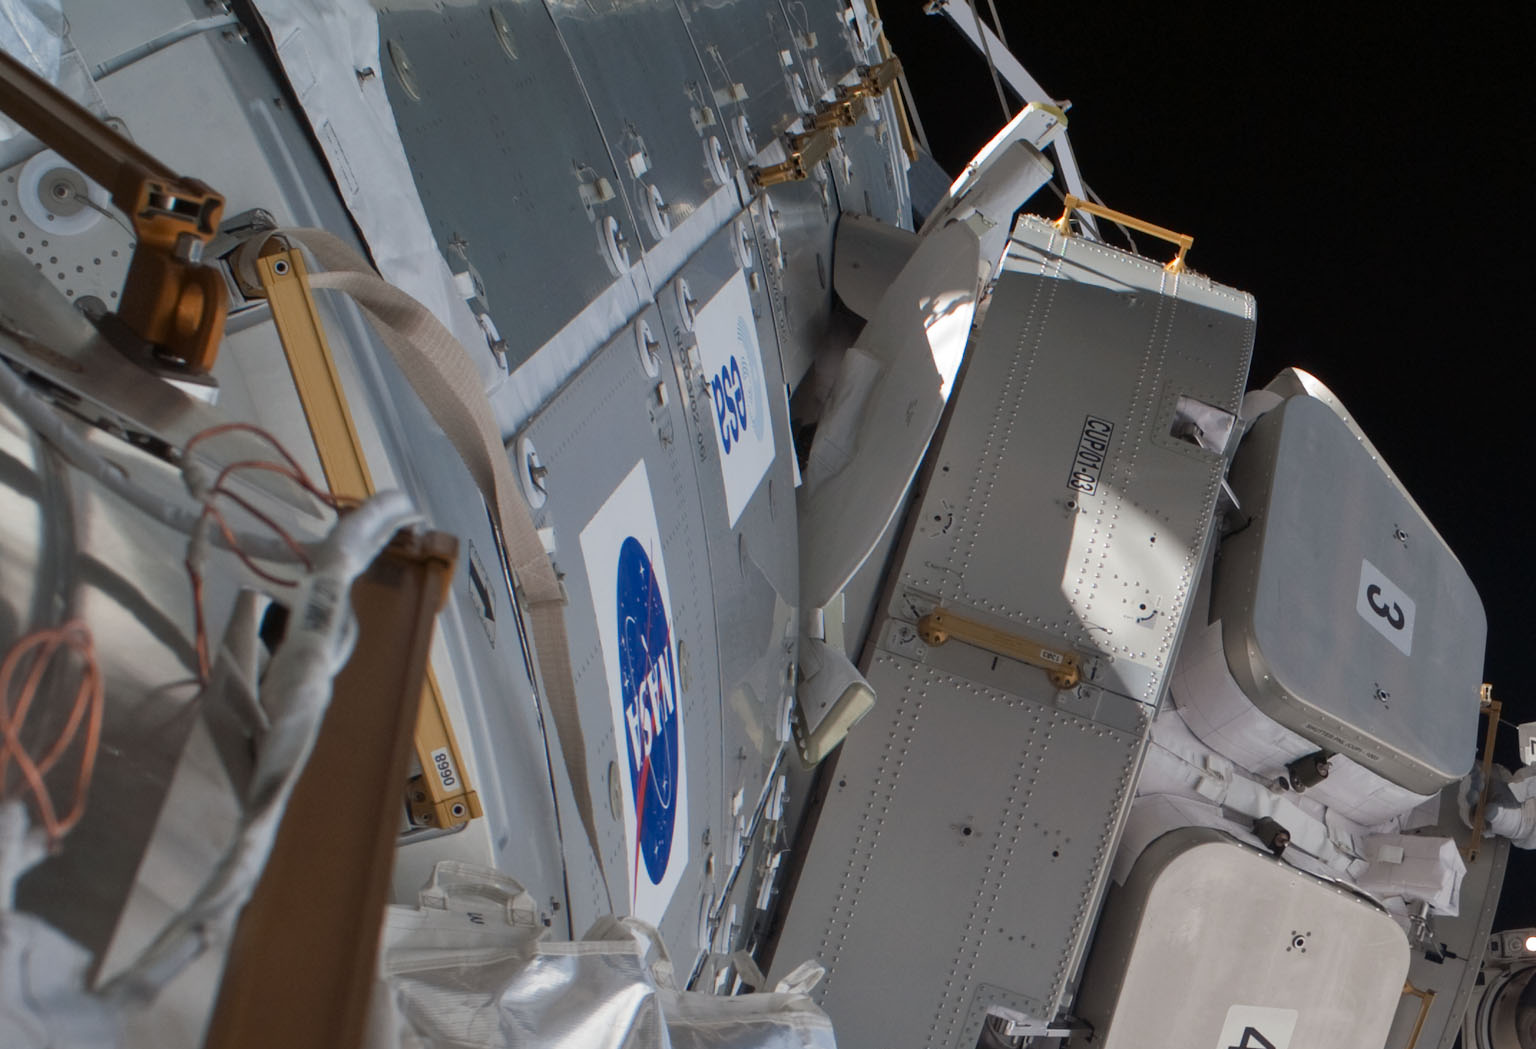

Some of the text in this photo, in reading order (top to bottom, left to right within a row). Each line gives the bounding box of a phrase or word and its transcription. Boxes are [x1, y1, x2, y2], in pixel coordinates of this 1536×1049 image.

[712, 355, 747, 455] esa
[1071, 420, 1111, 491] CUP/01-03
[1367, 585, 1404, 630] 3
[626, 645, 675, 772] NASA
[435, 753, 455, 786] 0668
